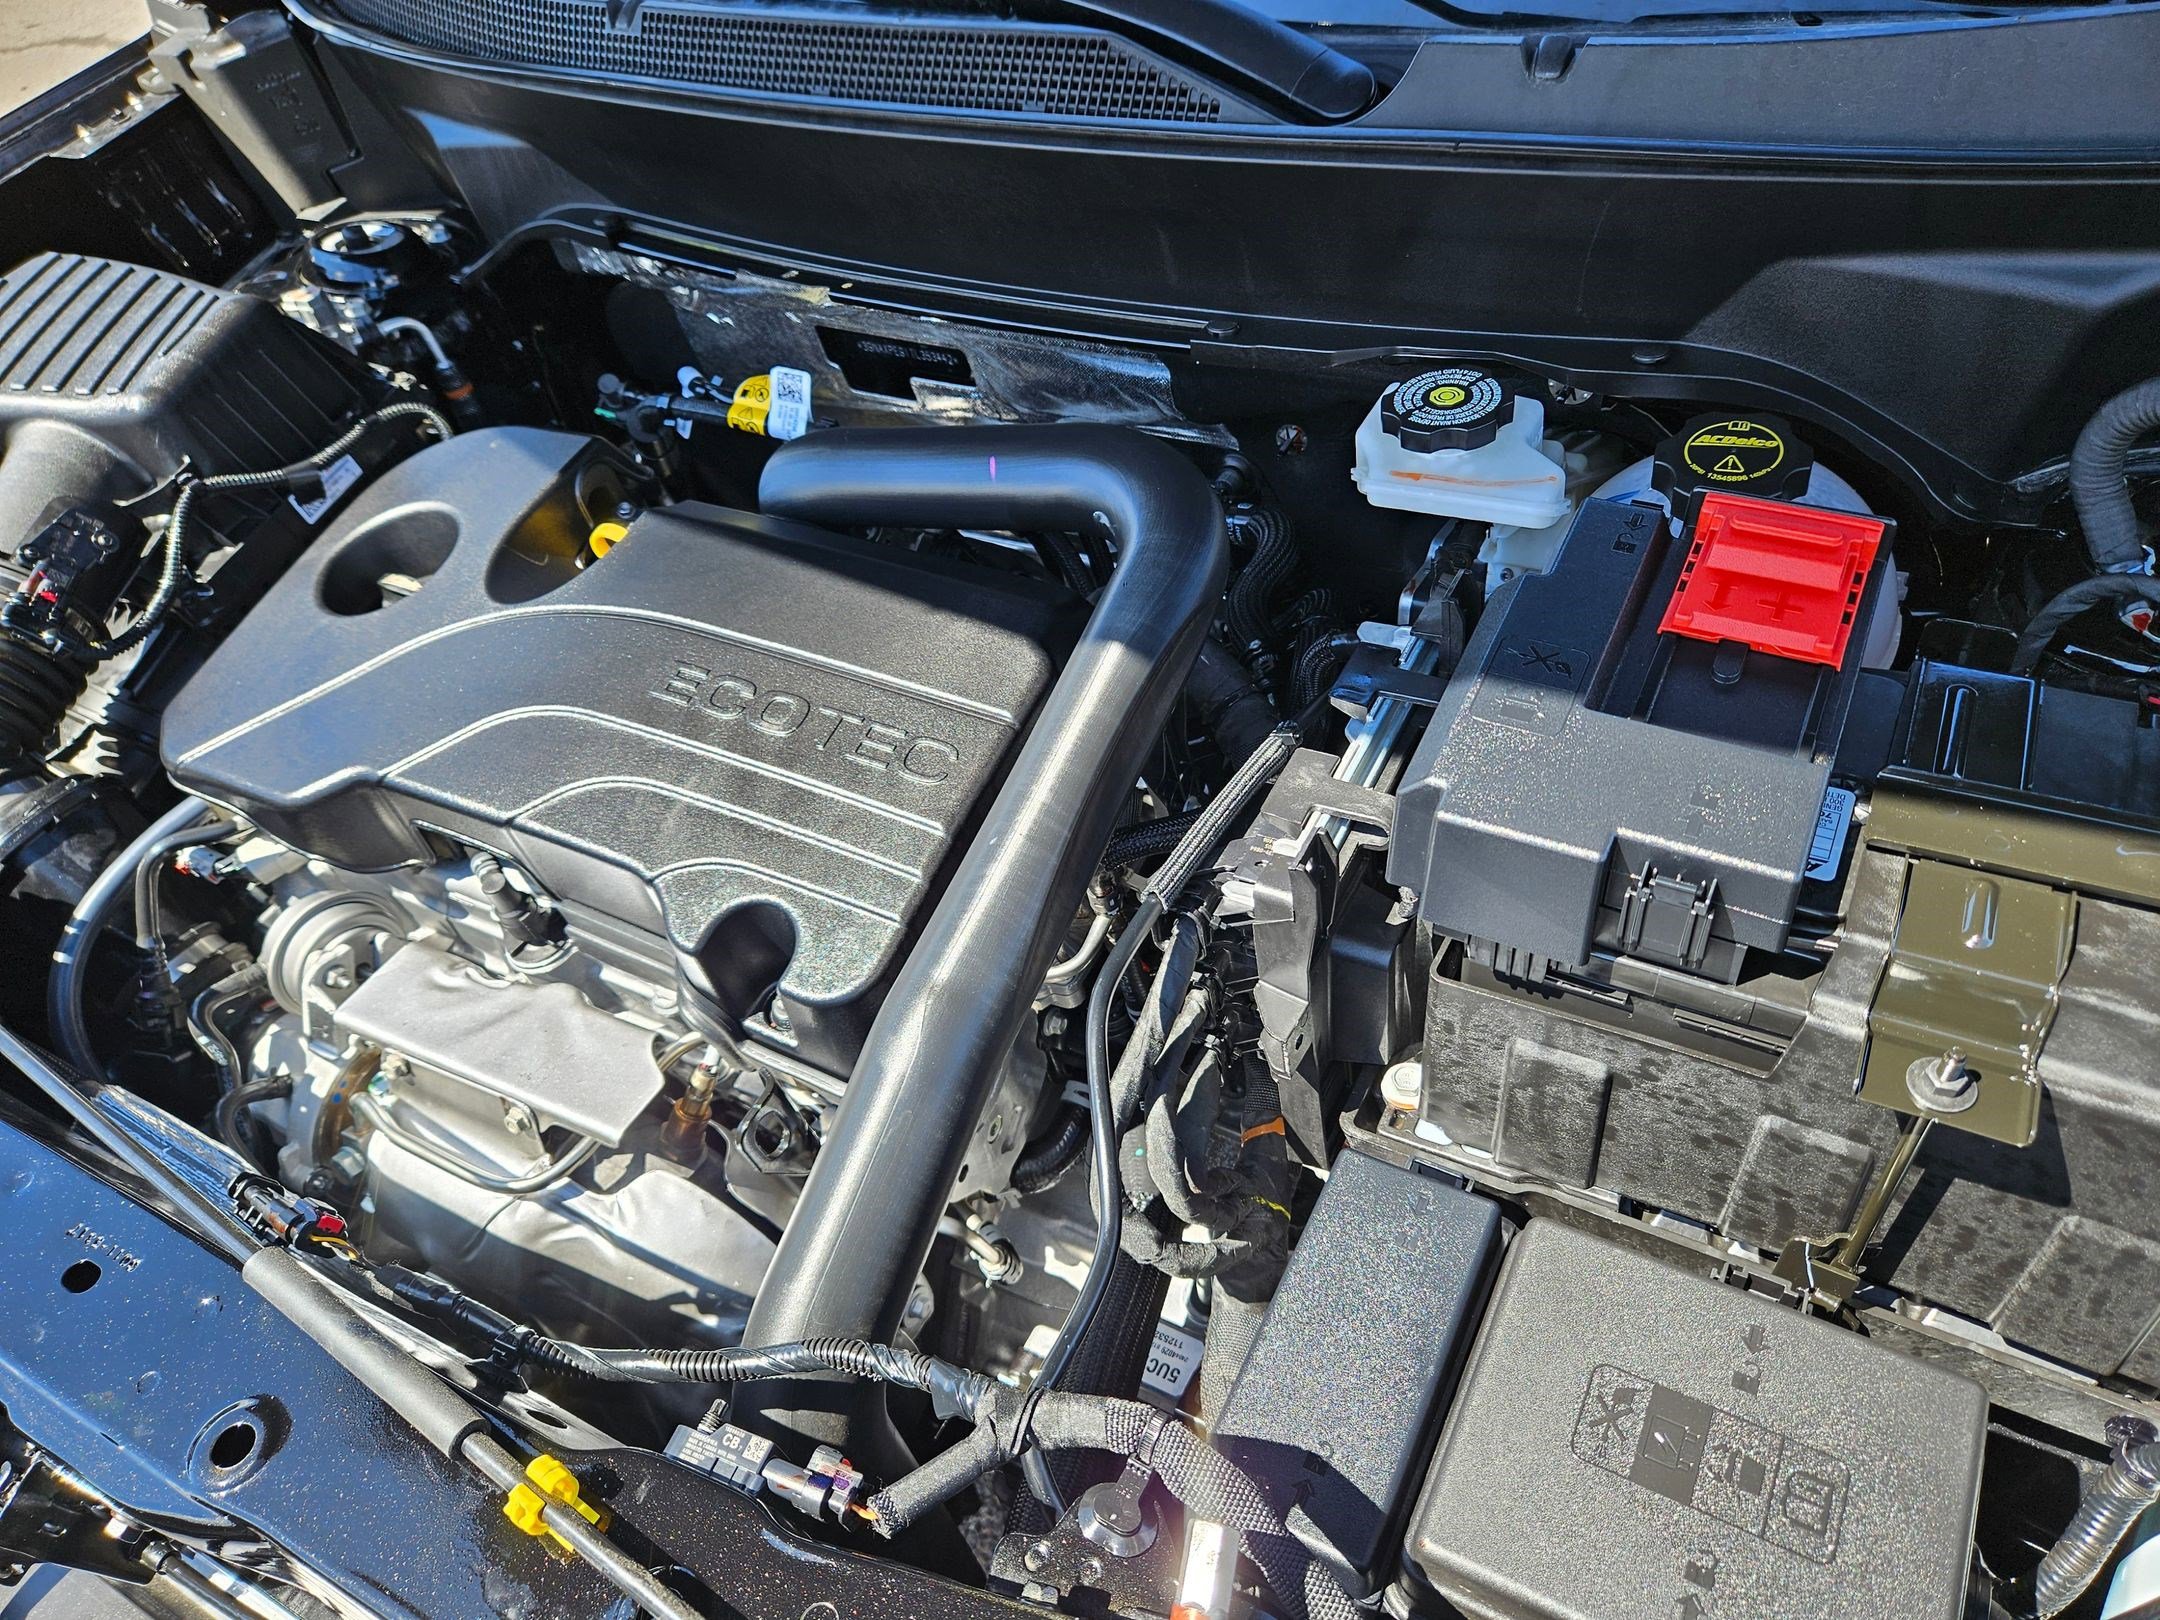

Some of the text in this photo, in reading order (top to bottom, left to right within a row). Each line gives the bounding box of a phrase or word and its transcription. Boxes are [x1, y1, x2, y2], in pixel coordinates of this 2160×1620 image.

[1419, 370, 1442, 378] FROM
[1451, 413, 1482, 424] BOUCHON
[1693, 434, 1779, 448] ACDelco
[1707, 472, 1748, 482] 13545896
[646, 660, 960, 785] ECOTEC
[1146, 1358, 1181, 1384] 5UC
